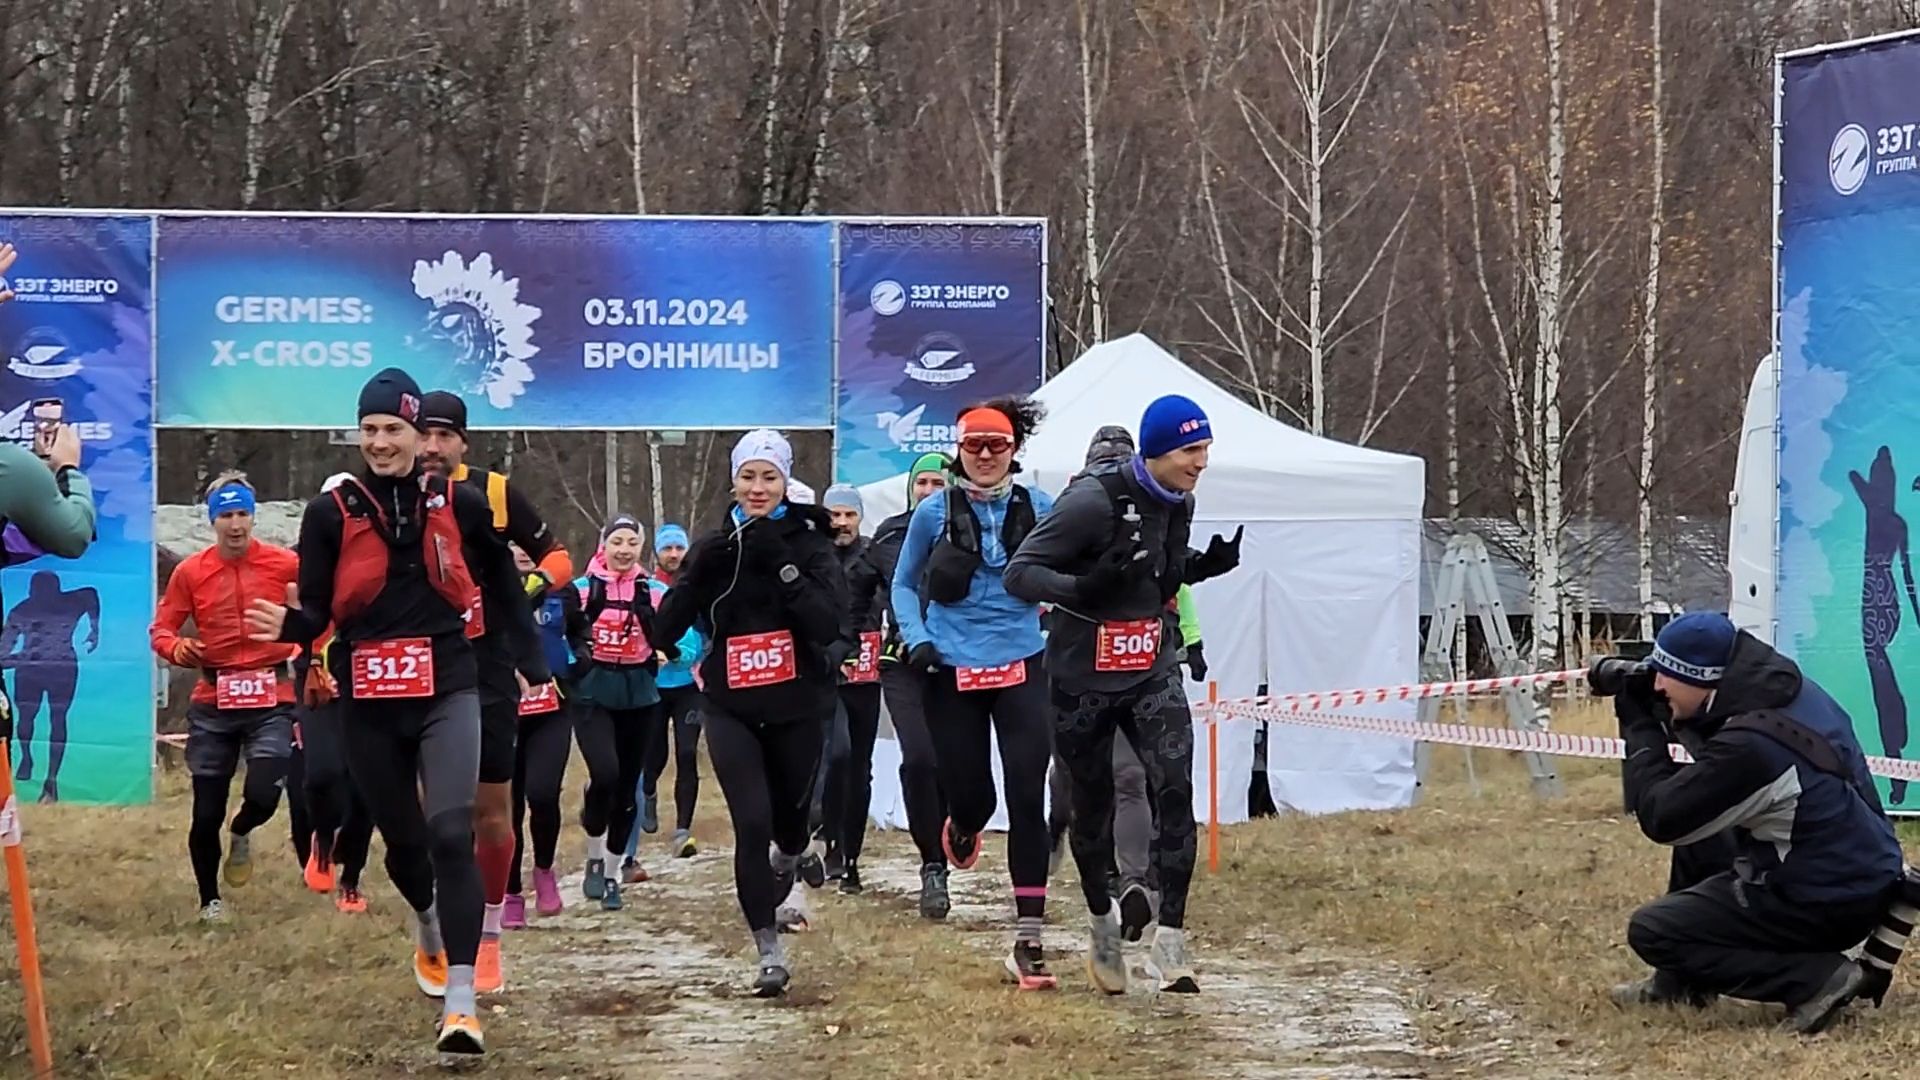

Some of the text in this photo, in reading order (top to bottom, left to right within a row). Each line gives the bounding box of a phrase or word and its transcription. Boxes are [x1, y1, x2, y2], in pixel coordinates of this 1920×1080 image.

[1876, 124, 1916, 155] ЗЭТ
[1876, 156, 1917, 175] ГРУППА
[14, 278, 119, 294] ЗЭТ ЭНЕРГО
[910, 285, 1010, 300] ЗЭТ ЭНЕРГО
[215, 296, 374, 323] GERMES:
[584, 298, 748, 326] 03.11.2024
[910, 300, 945, 309] ГРУППА
[211, 340, 373, 367] X-CROSS
[583, 342, 780, 373] БРОННИЦЫ
[1112, 632, 1155, 656] 506
[367, 656, 418, 680] 512
[740, 648, 783, 672] 505
[1653, 650, 1707, 679] armot
[229, 680, 266, 696] 501
